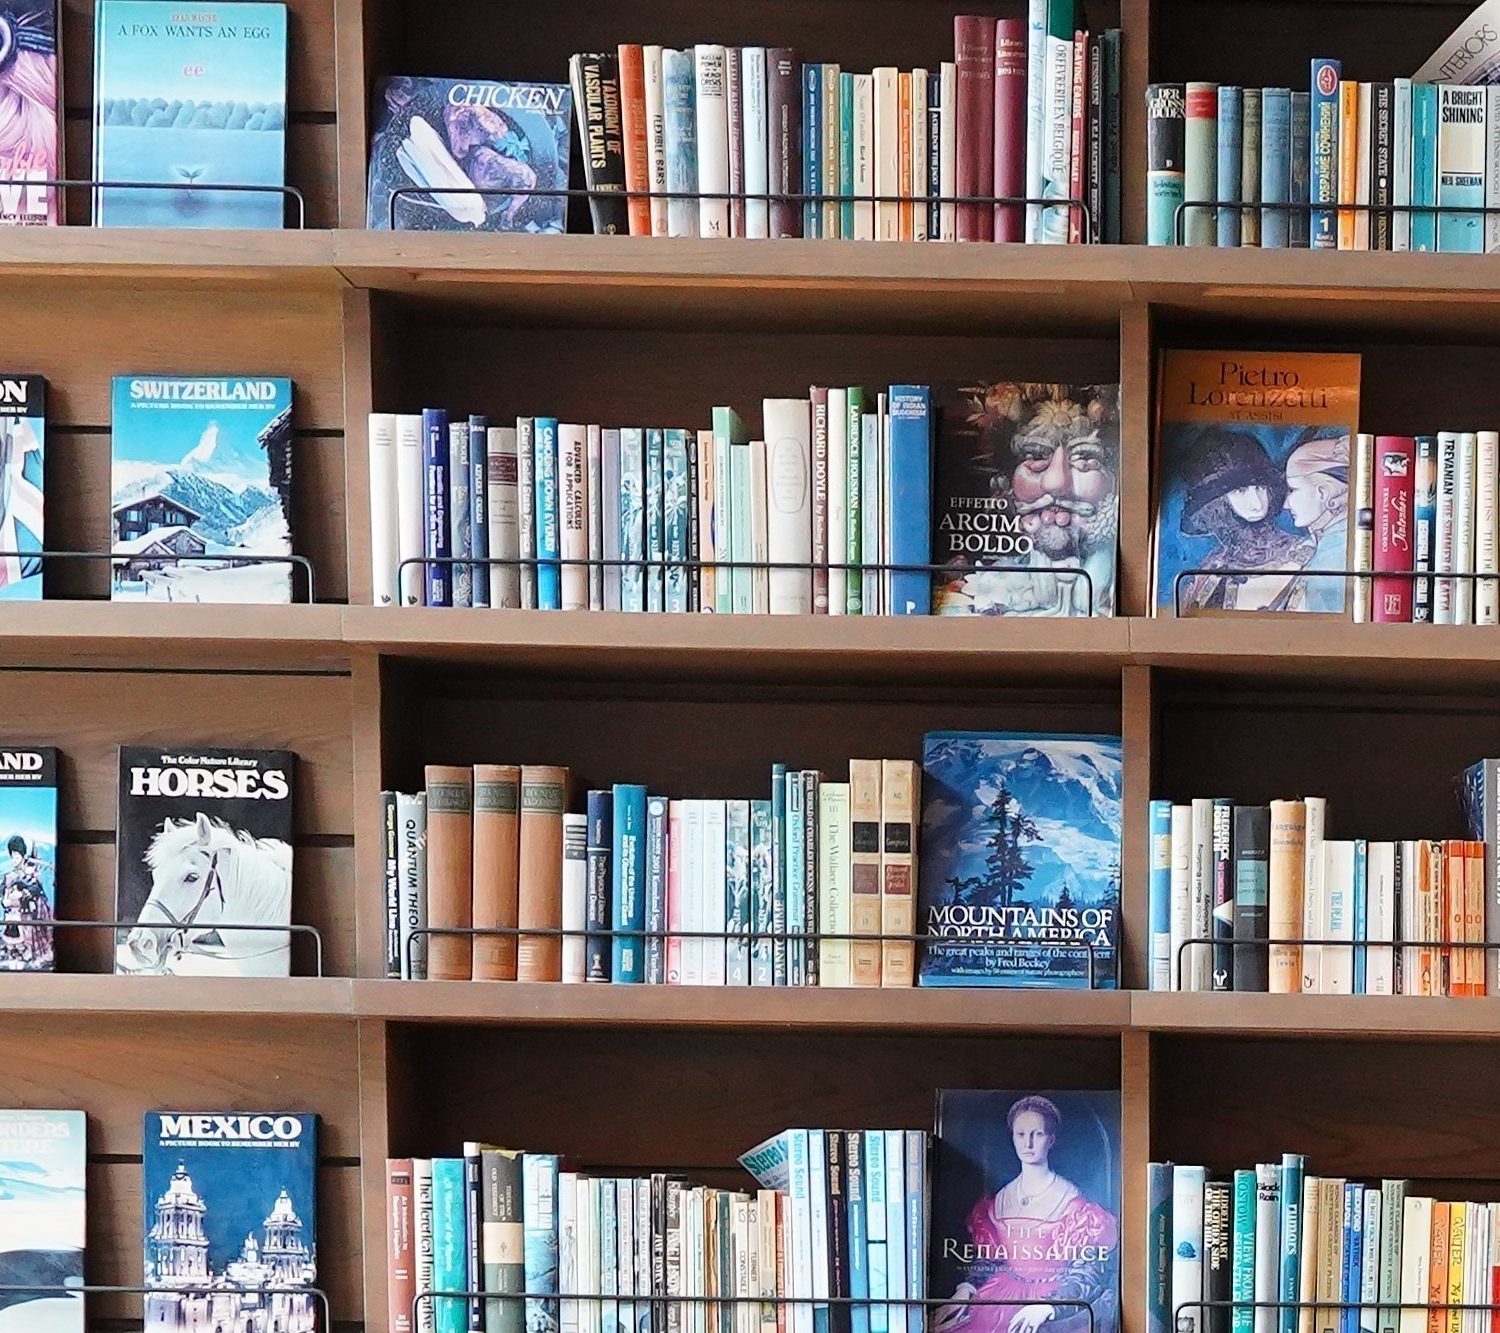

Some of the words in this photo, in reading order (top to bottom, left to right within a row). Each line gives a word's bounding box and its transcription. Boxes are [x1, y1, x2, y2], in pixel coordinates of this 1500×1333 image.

[117, 25, 128, 37] A
[131, 25, 158, 37] FOX
[164, 25, 214, 38] WANTS
[217, 26, 237, 39] AN
[243, 26, 270, 39] EGG
[448, 83, 566, 112] CHICKEN
[129, 379, 277, 401] SWITZERLAND
[949, 497, 1009, 511] EFFETTO
[940, 512, 1021, 534] ARCIM
[948, 535, 1035, 556] BOLDO
[130, 767, 289, 800] HORSES
[928, 905, 1079, 928] MOUNTAINS
[1084, 907, 1114, 928] OF
[158, 1115, 302, 1138] MEXICO
[943, 1240, 1110, 1264] RENAISSANCE
